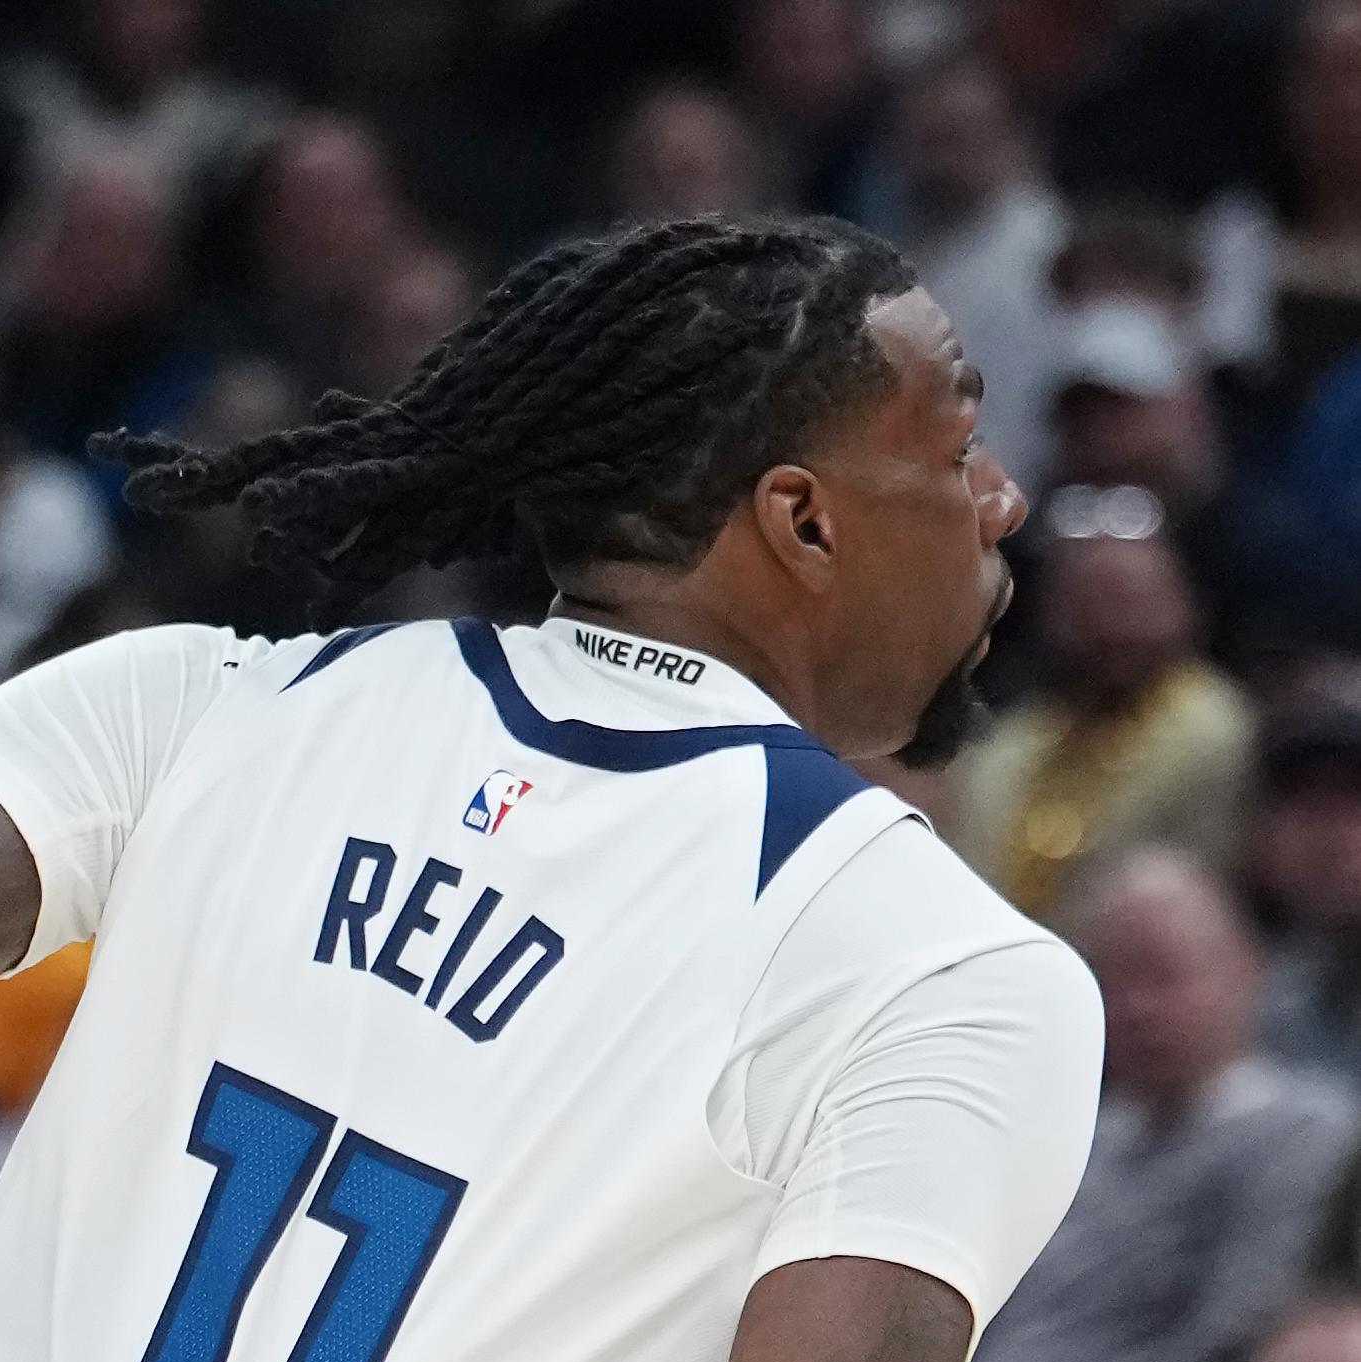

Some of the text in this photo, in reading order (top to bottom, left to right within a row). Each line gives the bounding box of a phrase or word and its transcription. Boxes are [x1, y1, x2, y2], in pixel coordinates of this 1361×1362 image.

[575, 628, 707, 686] NIKE PRO
[312, 836, 565, 1044] REID
